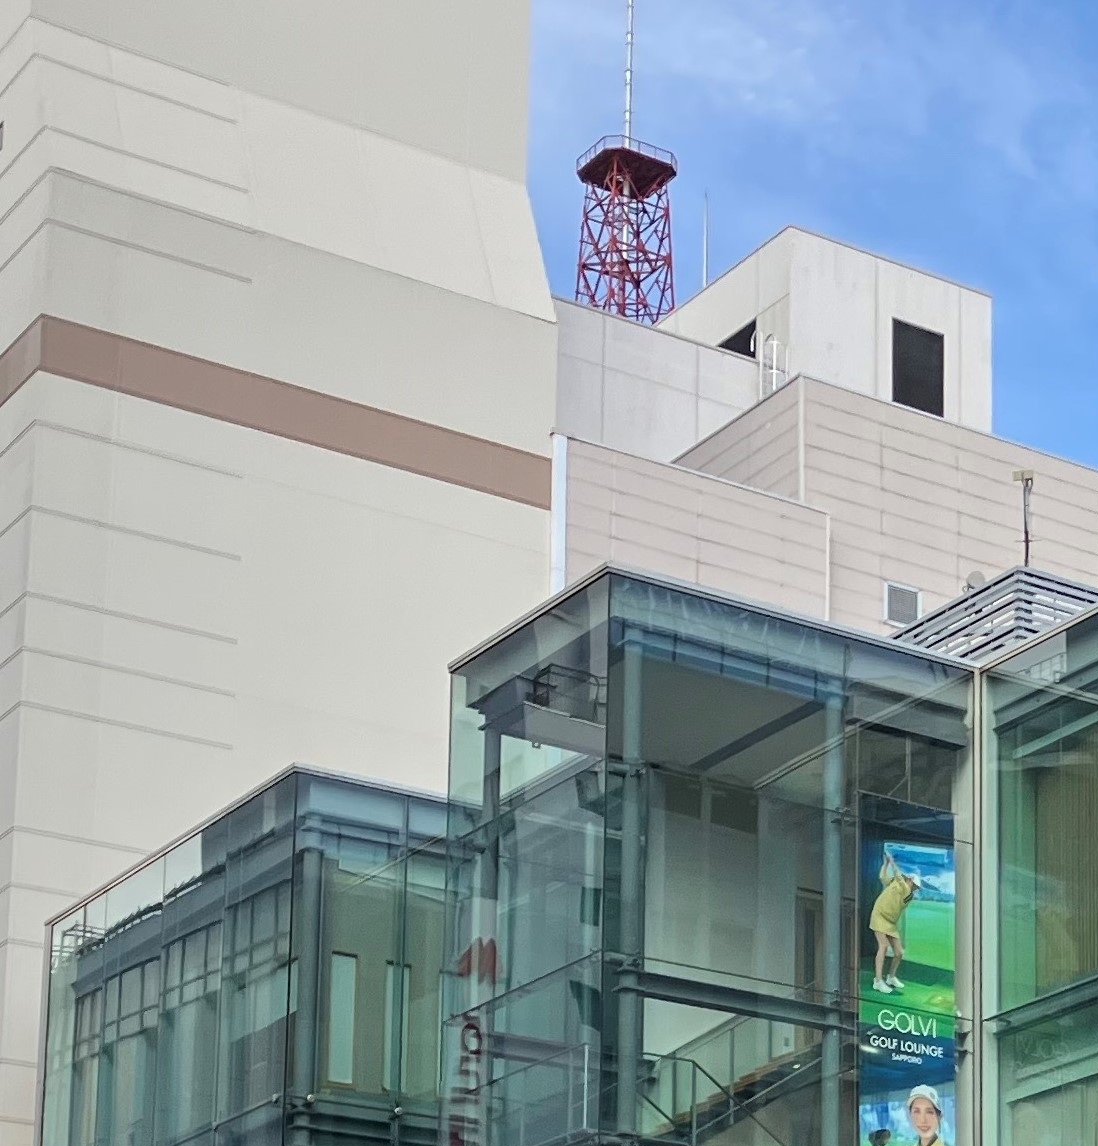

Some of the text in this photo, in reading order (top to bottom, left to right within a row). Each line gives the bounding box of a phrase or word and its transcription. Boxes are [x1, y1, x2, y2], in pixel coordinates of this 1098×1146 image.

[878, 1009, 937, 1039] GOLVI
[869, 1035, 944, 1059] GOLF LOUNGE
